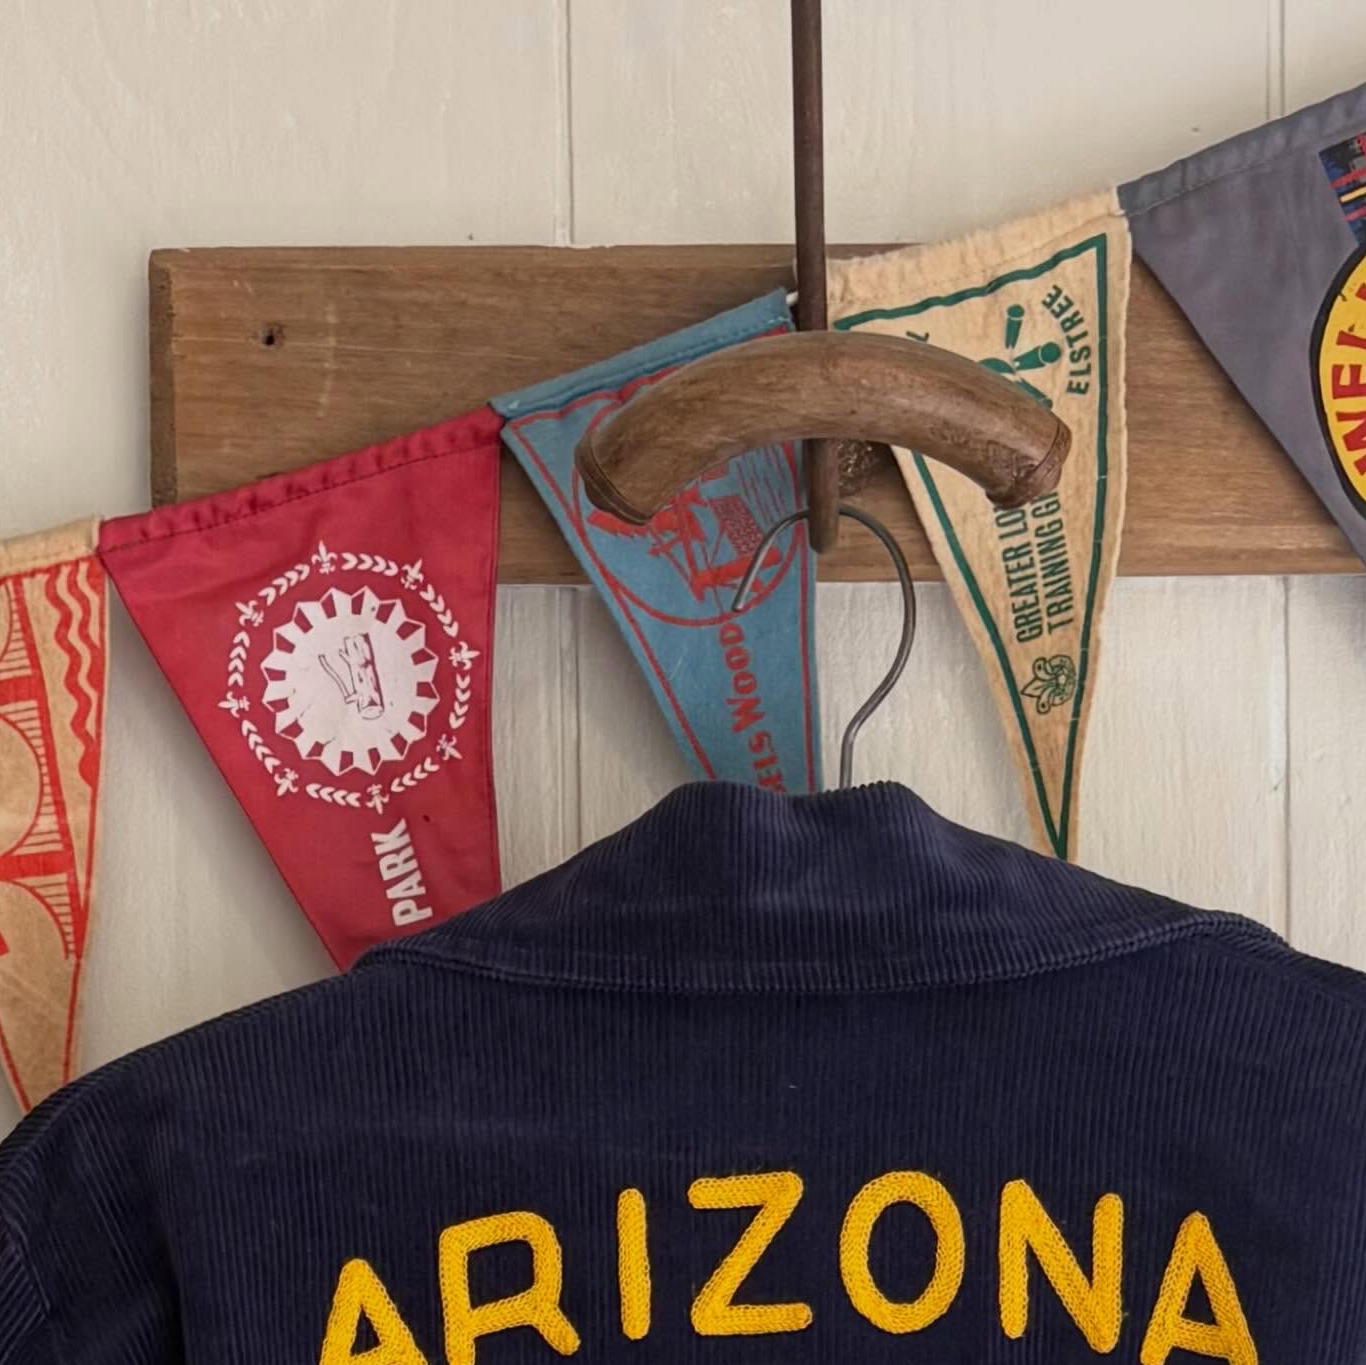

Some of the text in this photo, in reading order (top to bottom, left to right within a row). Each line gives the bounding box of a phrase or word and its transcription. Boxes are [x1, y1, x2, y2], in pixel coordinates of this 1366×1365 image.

[1041, 284, 1092, 396] ELSTREE
[1001, 541, 1043, 644] GREATER
[1035, 517, 1074, 635] TRAINING
[371, 818, 433, 926] PARK
